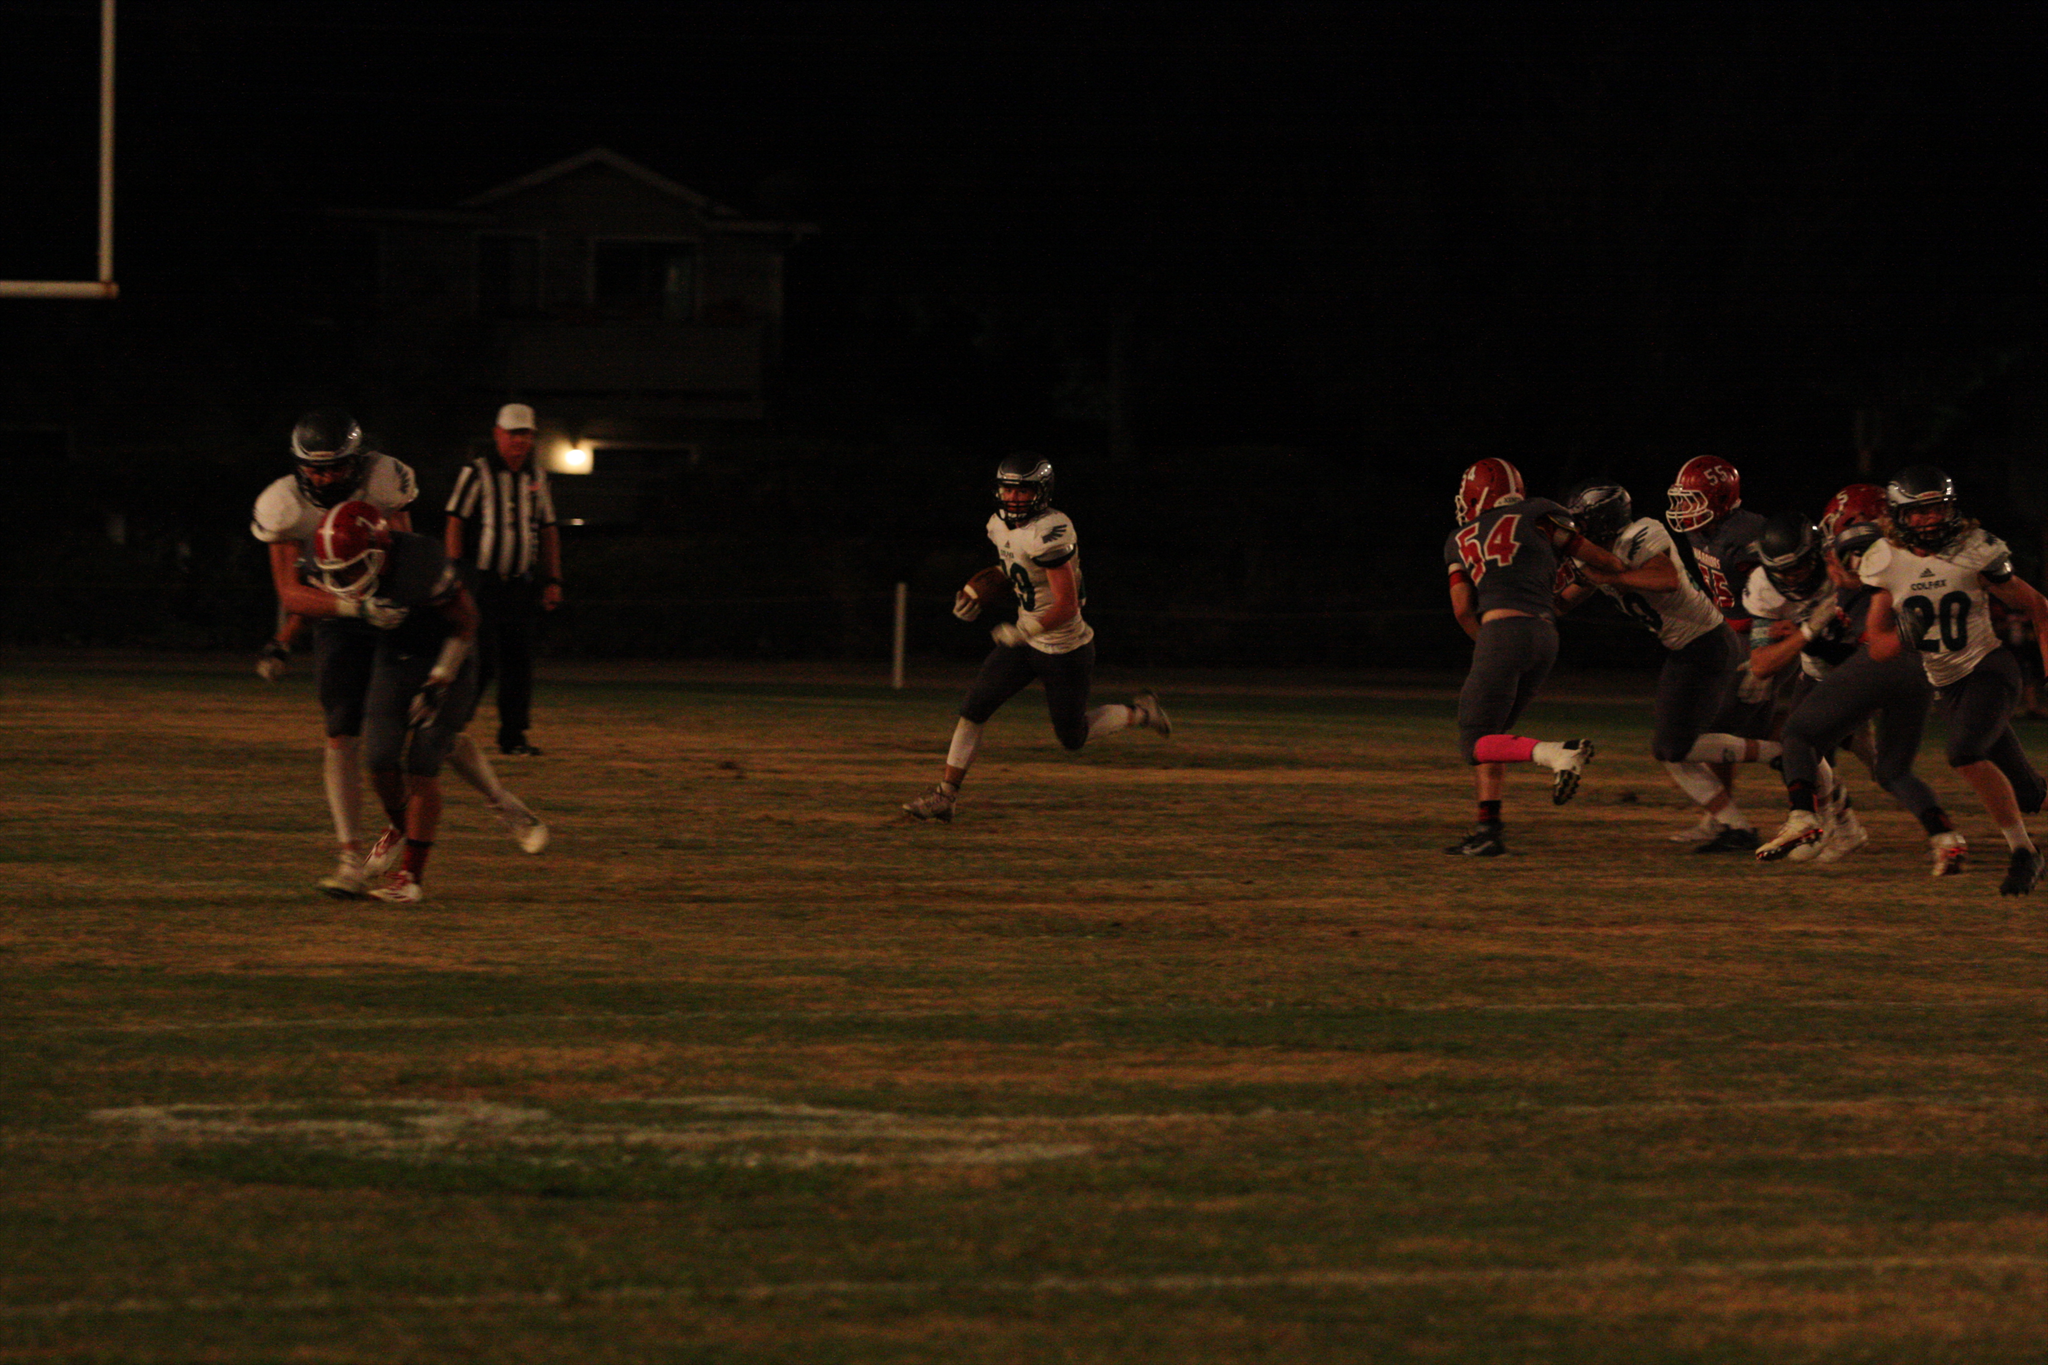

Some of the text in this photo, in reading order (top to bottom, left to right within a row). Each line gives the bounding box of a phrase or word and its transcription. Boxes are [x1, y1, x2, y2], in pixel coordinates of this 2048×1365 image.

[1703, 464, 1728, 486] 55
[1454, 513, 1523, 586] 54
[1902, 590, 1972, 652] 20
